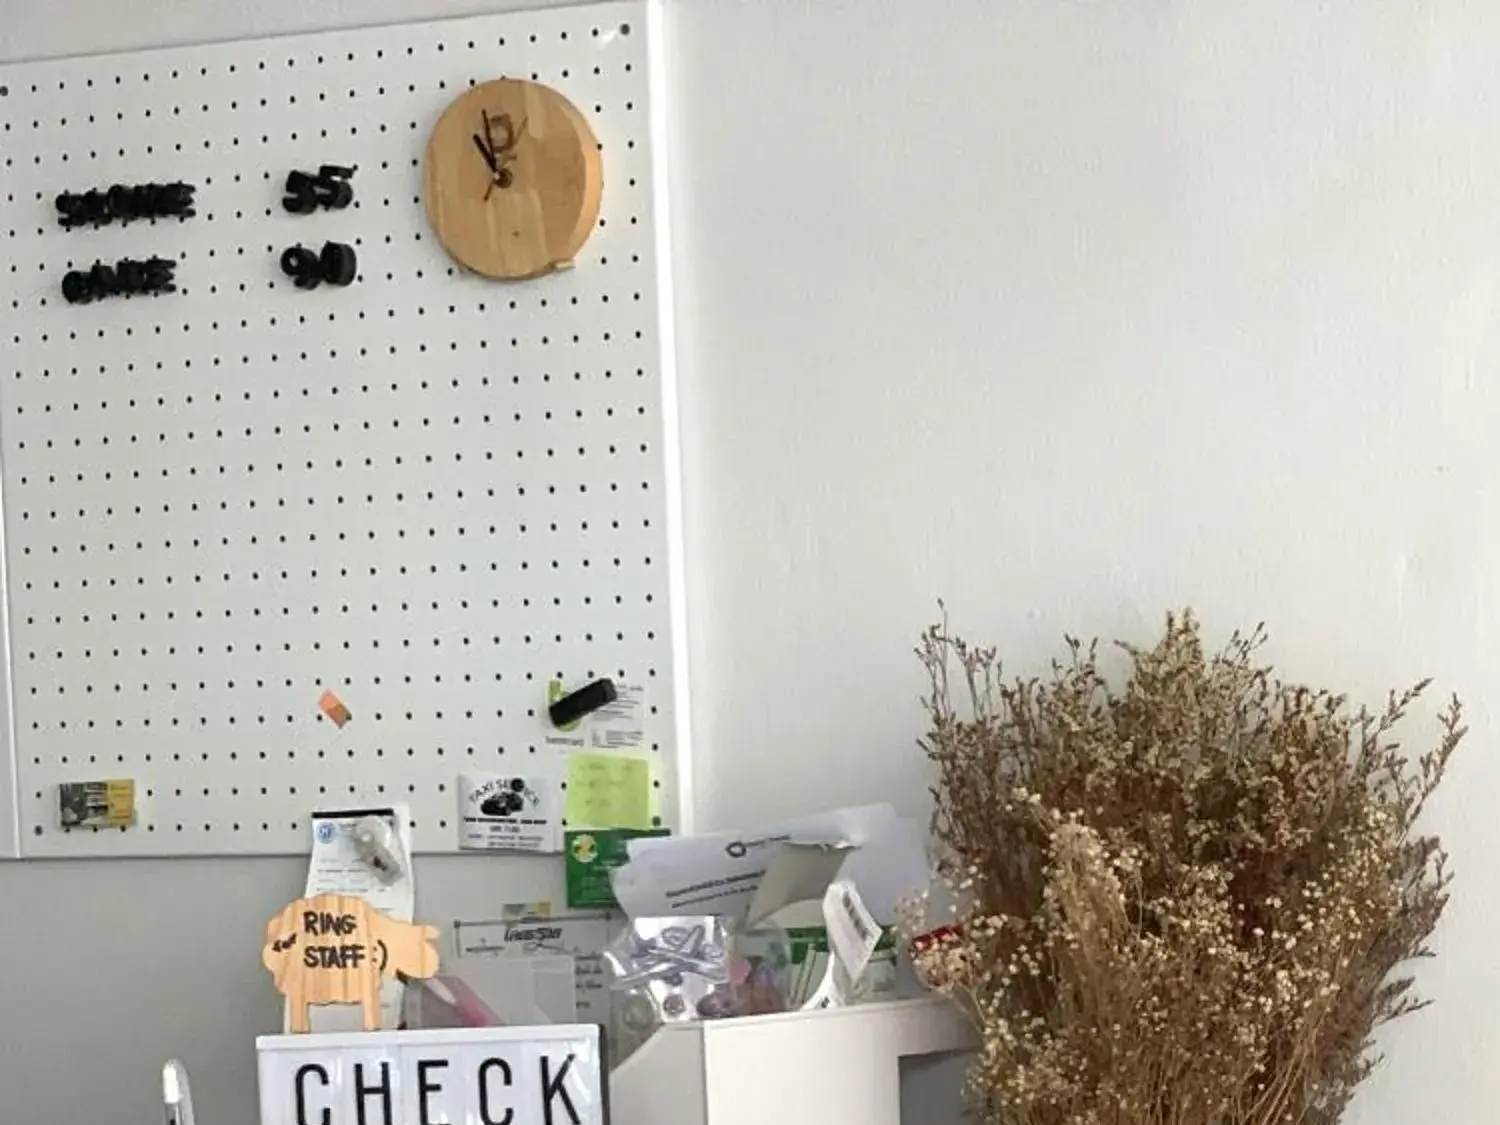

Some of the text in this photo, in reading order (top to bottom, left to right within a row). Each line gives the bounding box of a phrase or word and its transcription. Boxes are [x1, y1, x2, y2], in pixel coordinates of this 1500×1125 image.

[468, 782, 494, 806] TAXI
[303, 911, 357, 936] RING
[303, 944, 365, 969] STAFF
